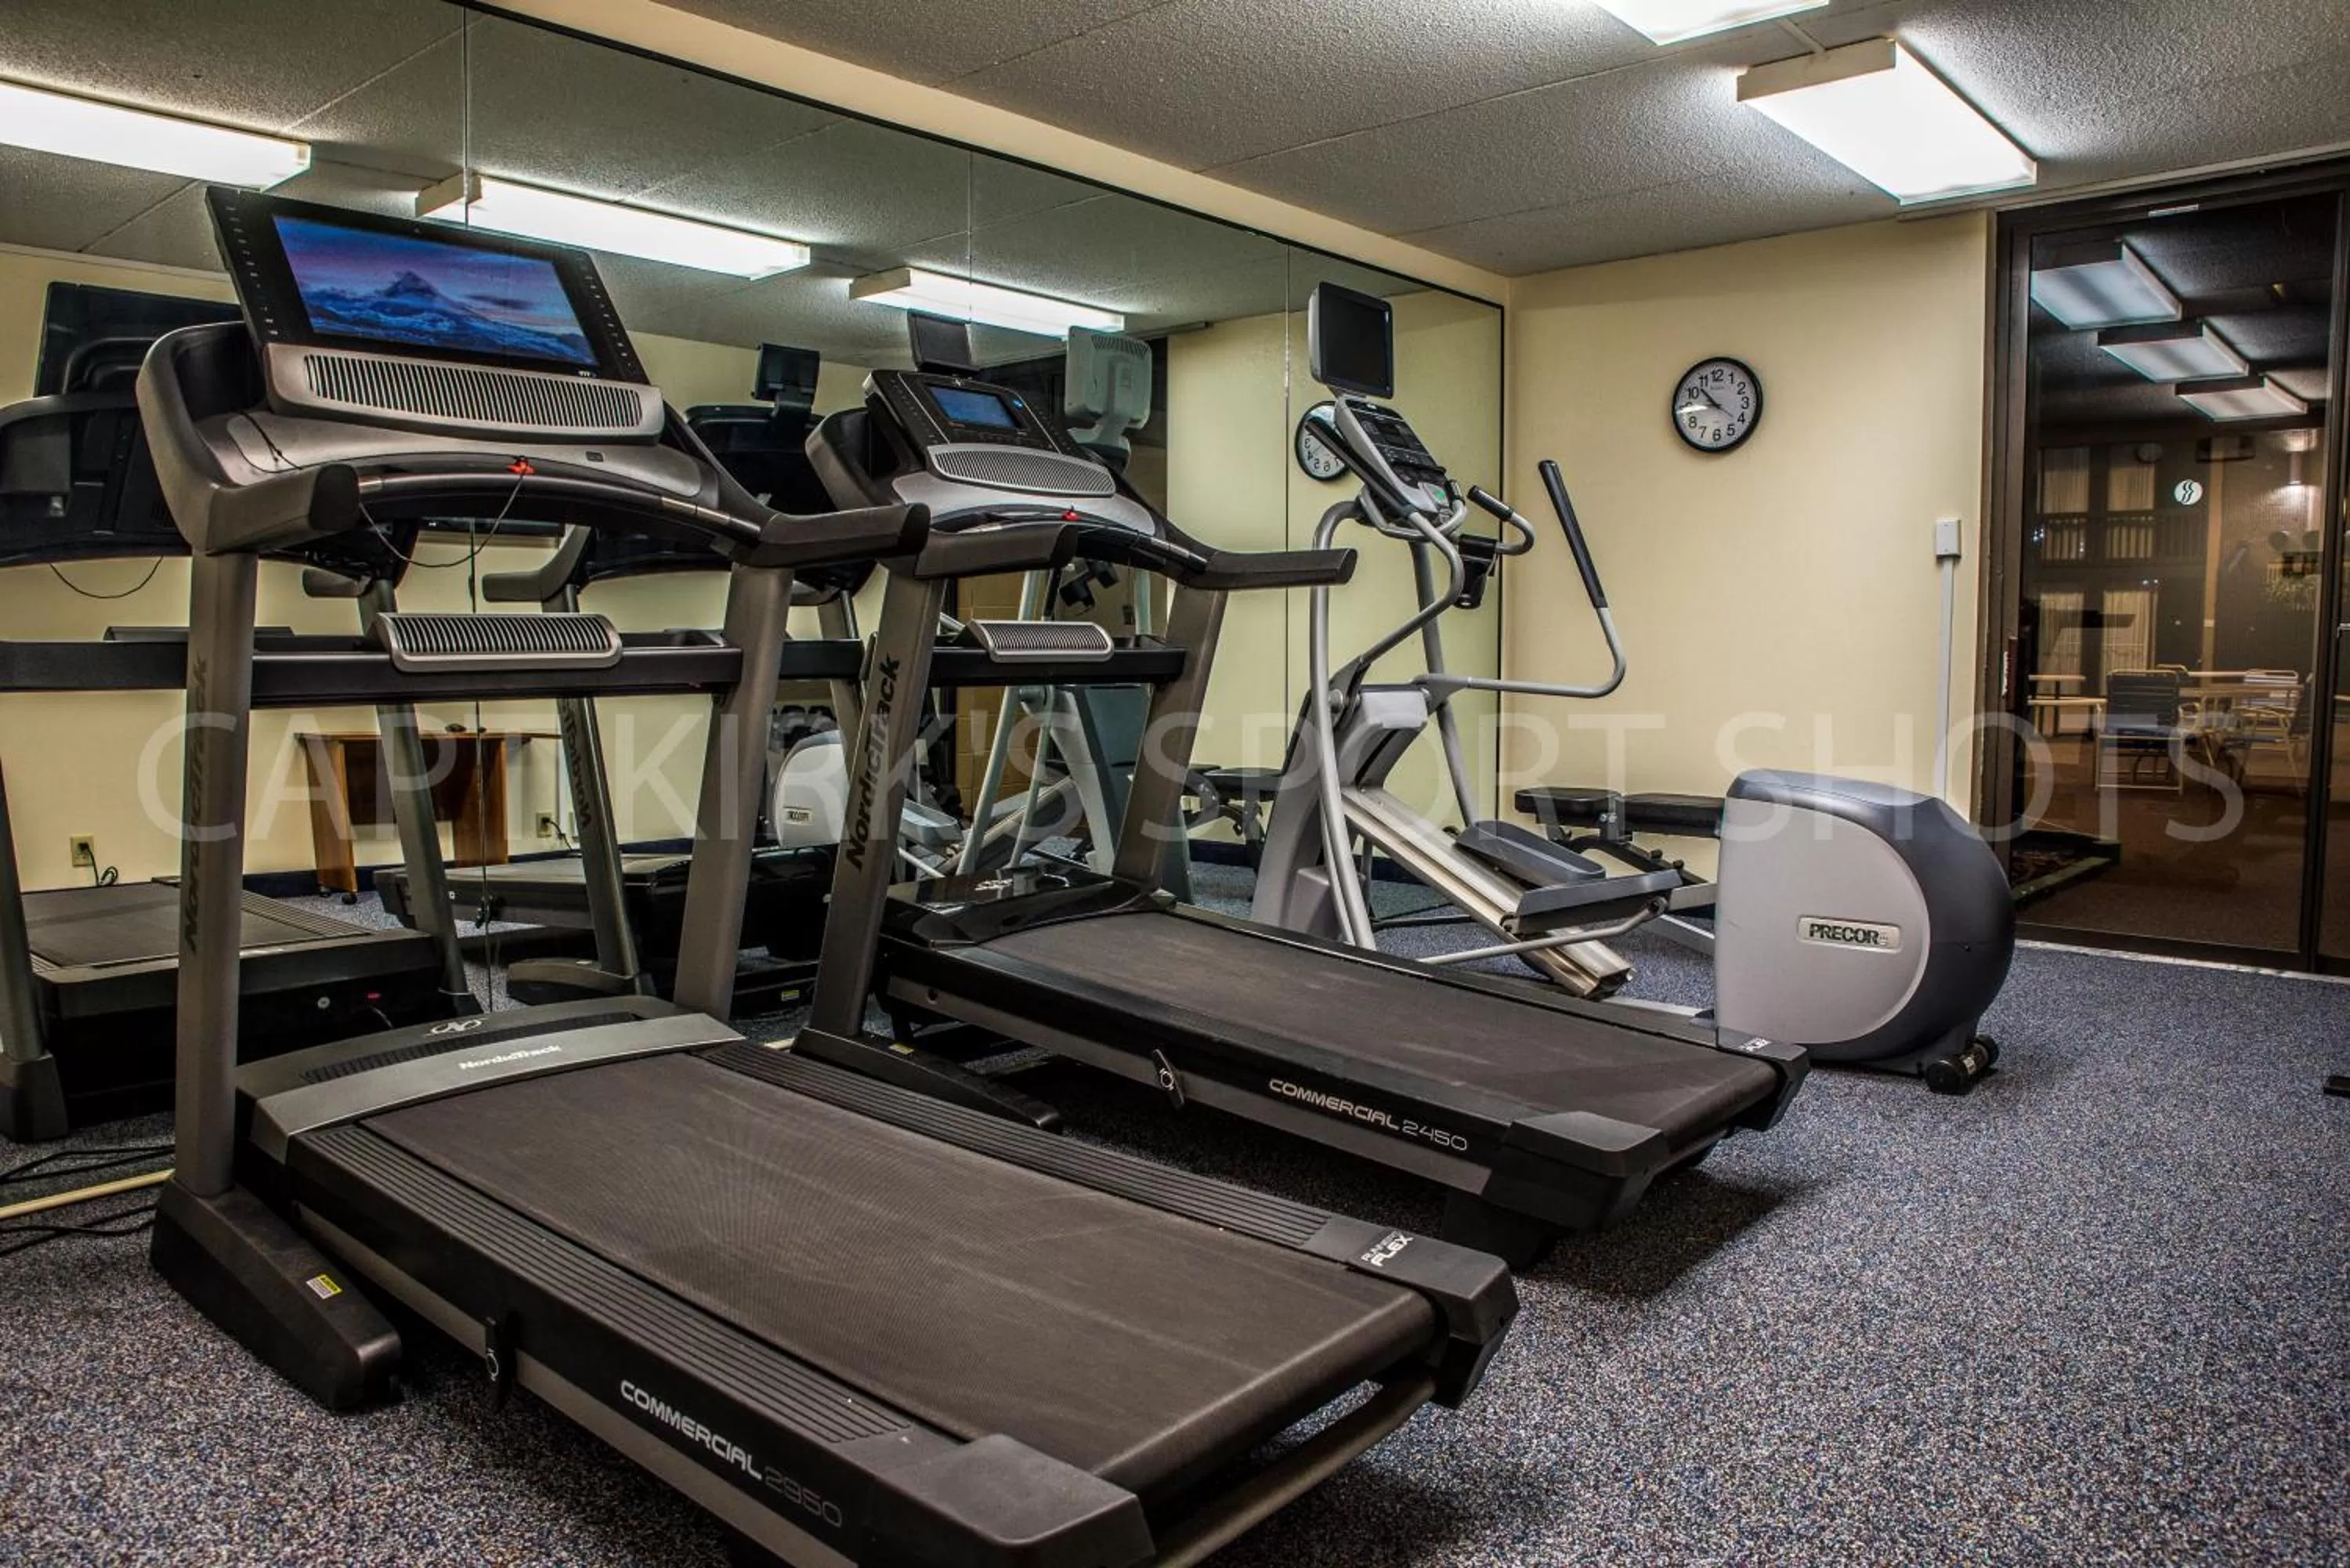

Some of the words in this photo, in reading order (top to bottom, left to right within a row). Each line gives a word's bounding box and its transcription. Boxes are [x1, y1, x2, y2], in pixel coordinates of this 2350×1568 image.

[1698, 375, 1708, 387] 11
[1711, 369, 1724, 381] 12
[1728, 371, 1734, 385] 1
[1687, 387, 1699, 399] 10
[1737, 382, 1746, 395] 2
[1741, 396, 1749, 410] 3
[1688, 416, 1697, 428] 8
[1737, 412, 1746, 425] 4
[1699, 426, 1707, 439] 7
[1712, 428, 1722, 442] 6
[1727, 423, 1735, 436] 5
[846, 652, 900, 873] NordicTrack
[1809, 923, 1879, 945] PRECOR
[1269, 1078, 1400, 1130] COMMERCIAL
[1401, 1120, 1468, 1151] 2450
[1370, 1234, 1414, 1266] FLEX
[620, 1379, 763, 1480] COMMERCIAL
[764, 1465, 842, 1528] 2950
